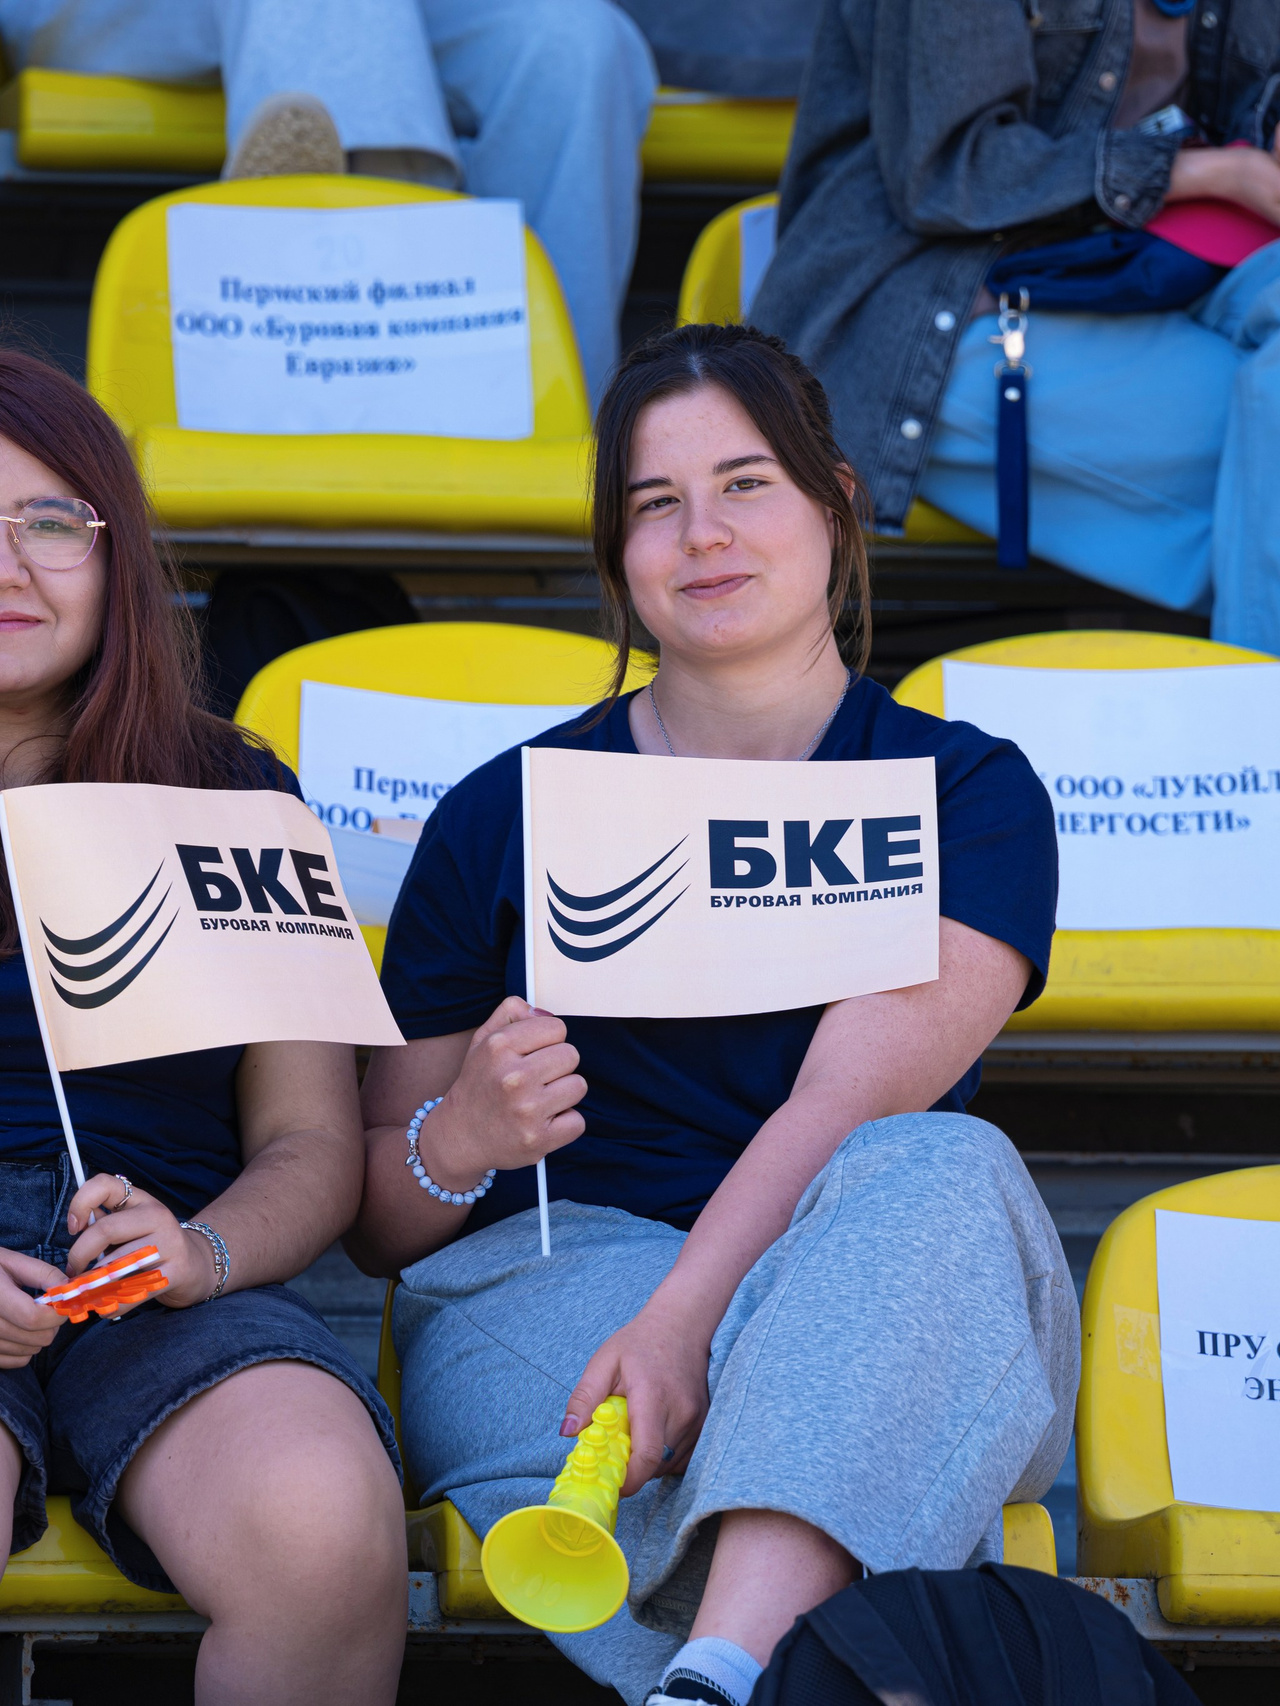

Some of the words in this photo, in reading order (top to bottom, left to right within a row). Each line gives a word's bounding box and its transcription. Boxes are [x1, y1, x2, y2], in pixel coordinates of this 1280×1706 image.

[220, 277, 360, 309] Пермский
[368, 276, 475, 309] филиал
[176, 310, 243, 339] ООО
[249, 316, 380, 346] «Буровая
[388, 307, 525, 338] компания
[285, 352, 417, 382] Евразия»
[1055, 775, 1124, 800] ООО
[708, 815, 923, 889] БКЕ
[175, 843, 348, 922] БКЕ
[710, 894, 801, 908] БУРОВАЯ
[812, 883, 923, 906] КОМПАНИЯ
[200, 918, 271, 932] БУРОВАЯ
[276, 921, 354, 940] КОМПАНИЯ
[1196, 1329, 1267, 1360] ПРУ
